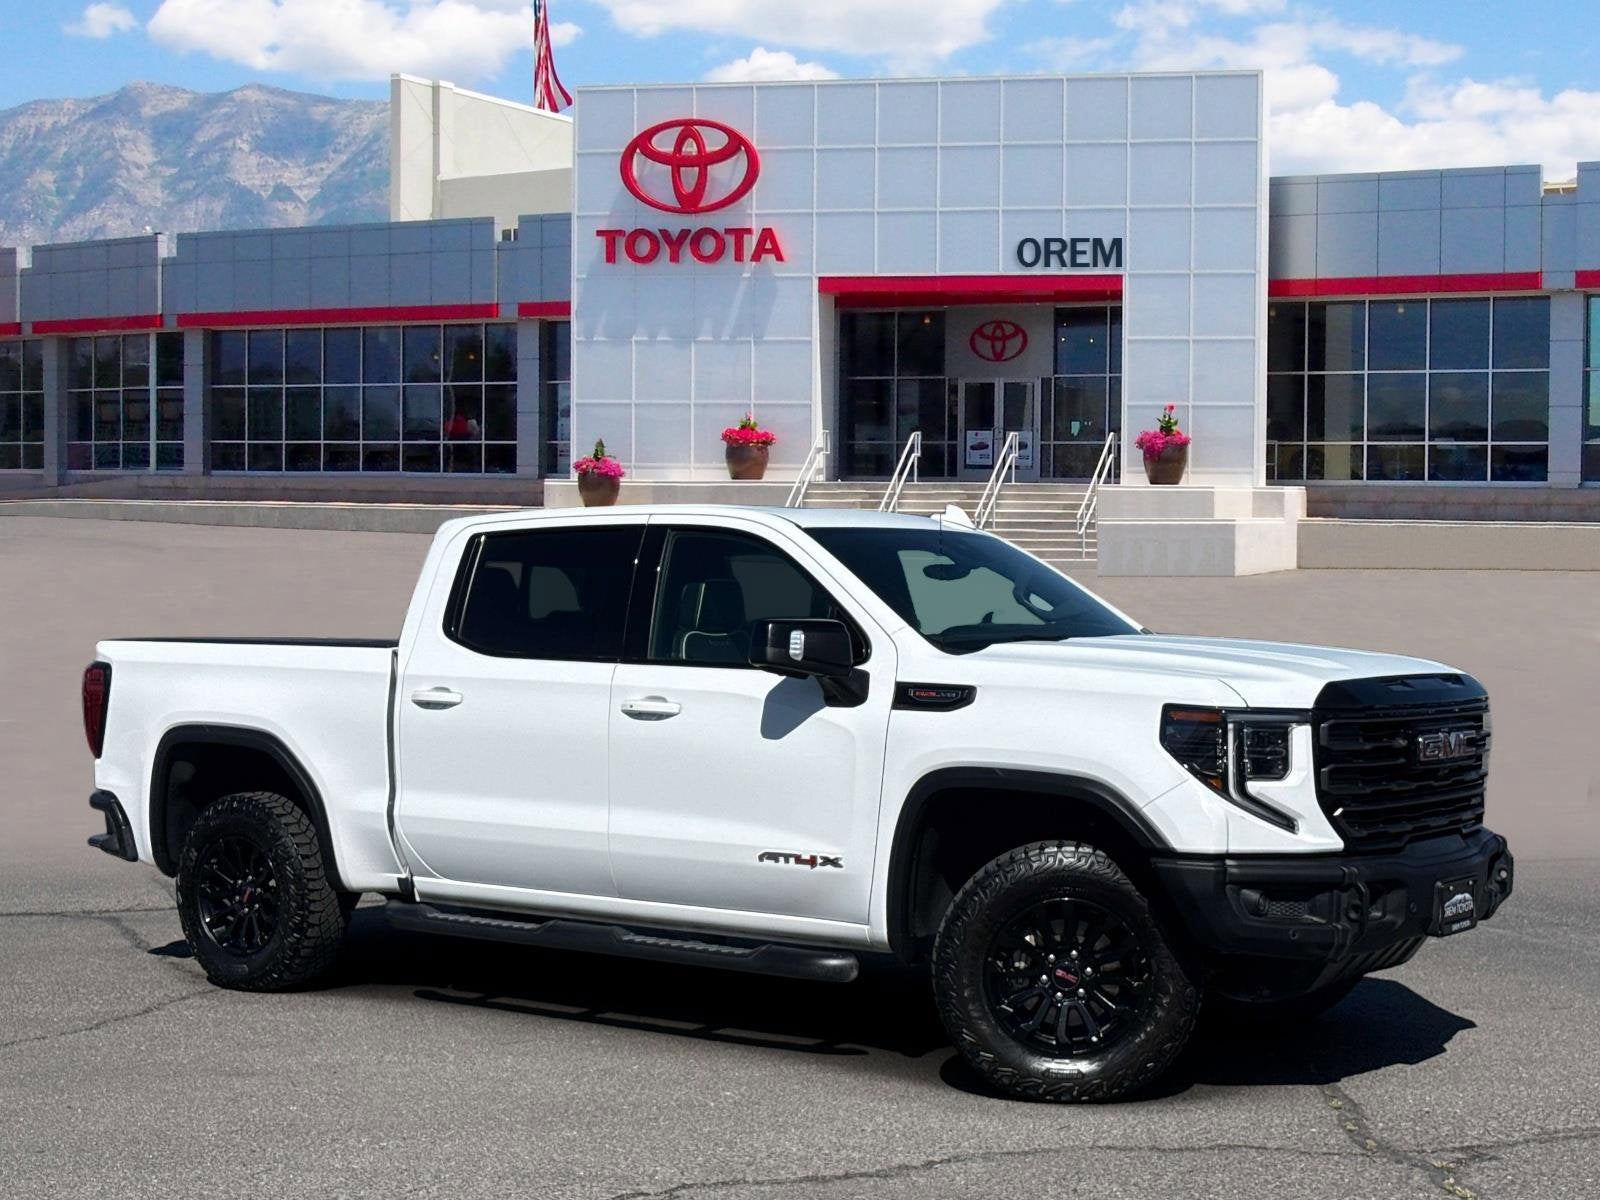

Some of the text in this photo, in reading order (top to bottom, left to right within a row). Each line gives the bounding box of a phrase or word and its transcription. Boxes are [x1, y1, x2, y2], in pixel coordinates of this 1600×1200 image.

[595, 227, 785, 264] TOYOTA
[1017, 237, 1123, 268] OREM
[1418, 729, 1477, 761] GMC
